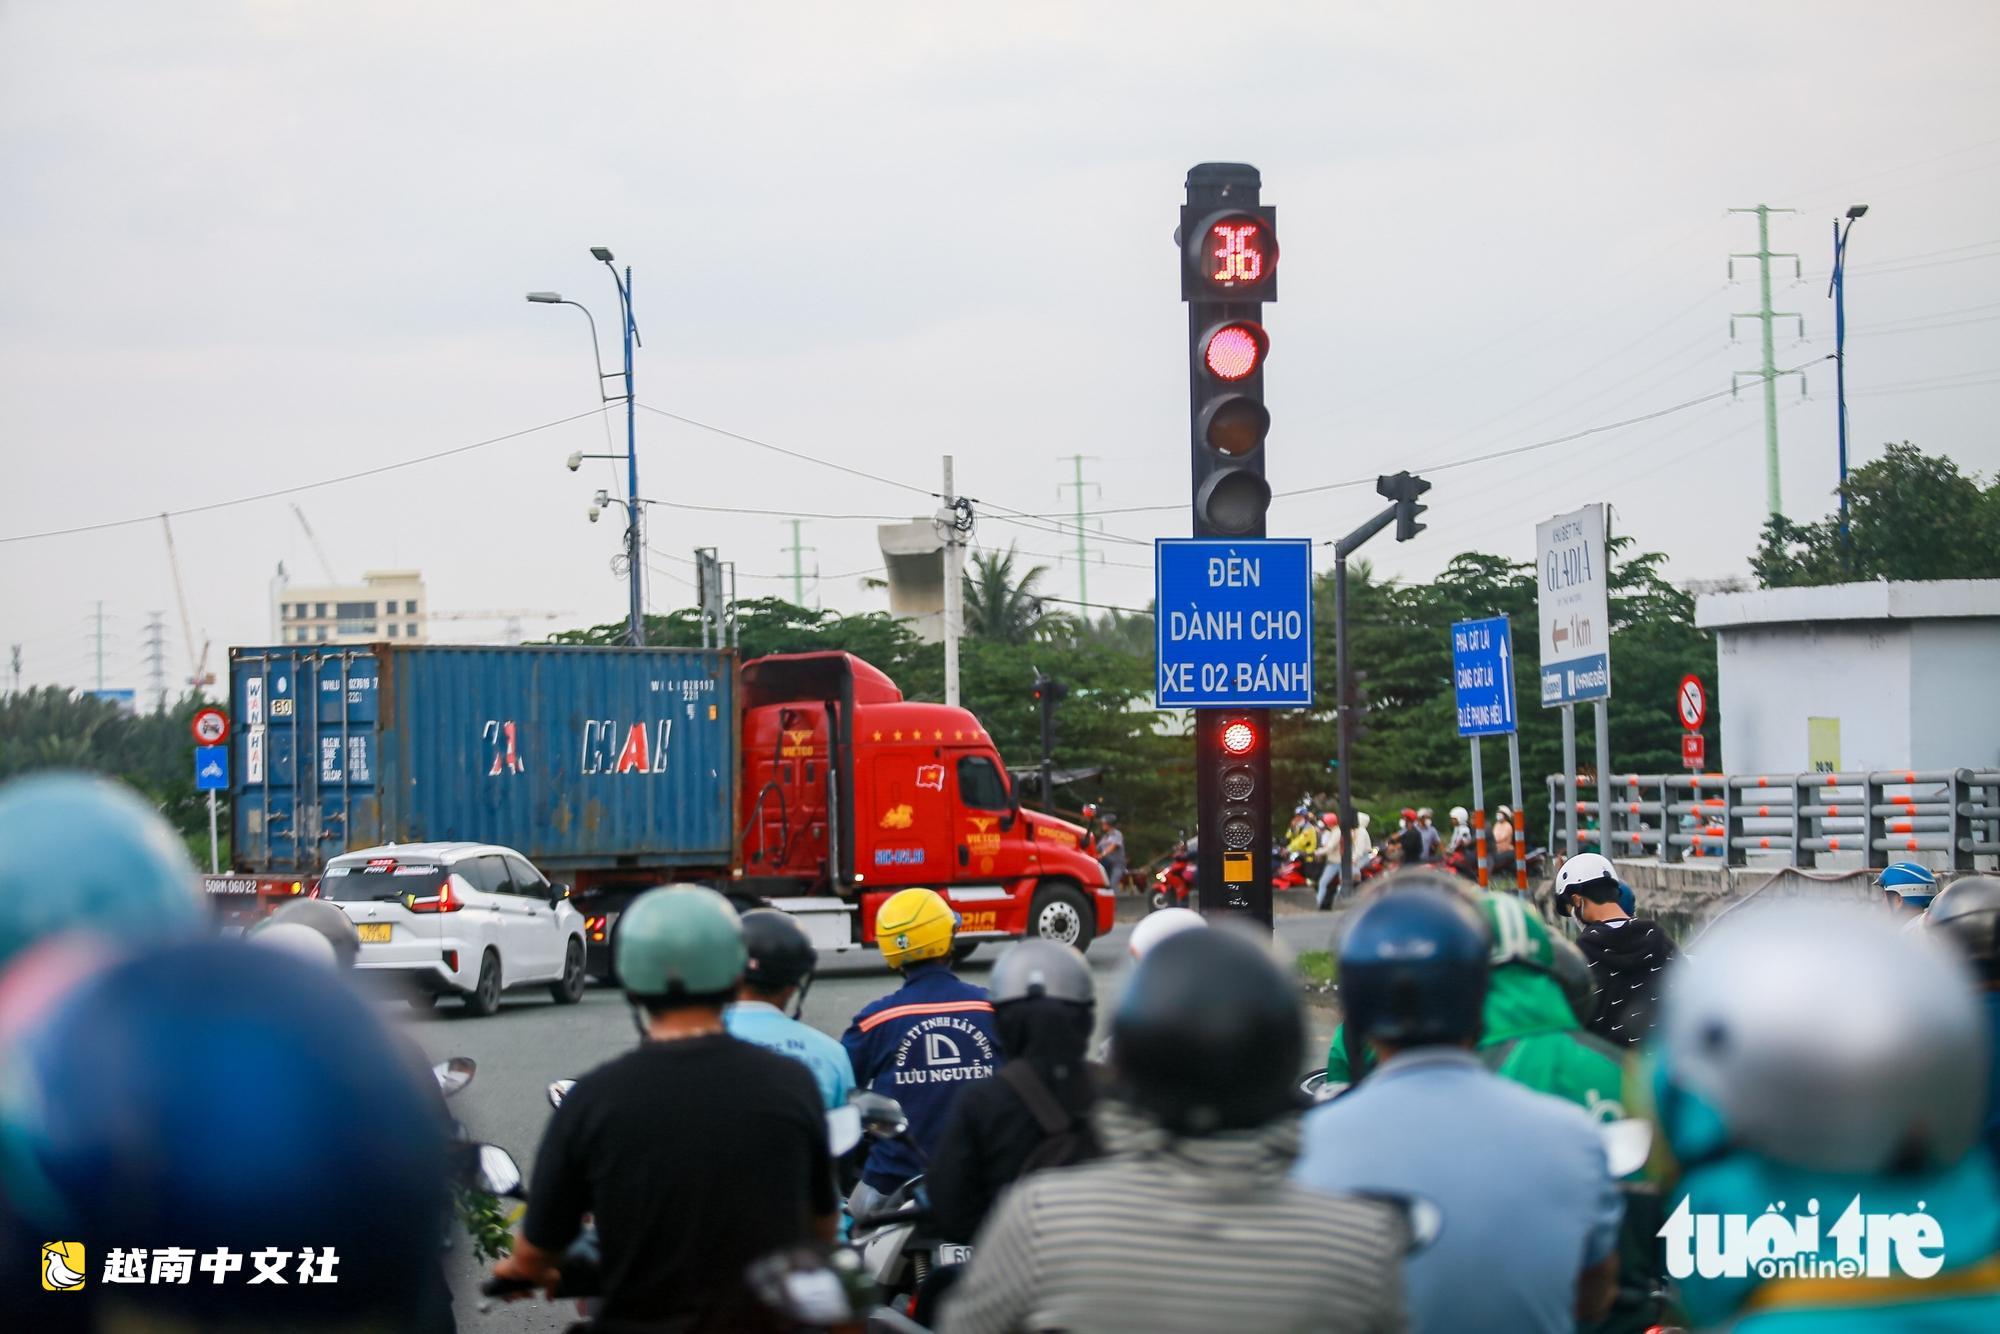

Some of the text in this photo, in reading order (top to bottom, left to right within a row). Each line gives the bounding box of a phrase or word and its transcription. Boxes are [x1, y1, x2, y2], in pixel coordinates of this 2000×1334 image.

[1214, 226, 1260, 280] 36
[1208, 549, 1260, 587] ĐÈN
[1547, 540, 1592, 592] GLADIA
[1171, 602, 1301, 641] DÀNH CHO
[1162, 654, 1308, 692] XE 02 BÁNH
[246, 880, 257, 892] 22
[896, 1039, 912, 1066] CÔNG
[907, 1026, 922, 1040] TY
[920, 1016, 951, 1031] TNHH
[952, 1018, 976, 1035] XÂY
[895, 1059, 993, 1085] LƯU NGUYỄN
